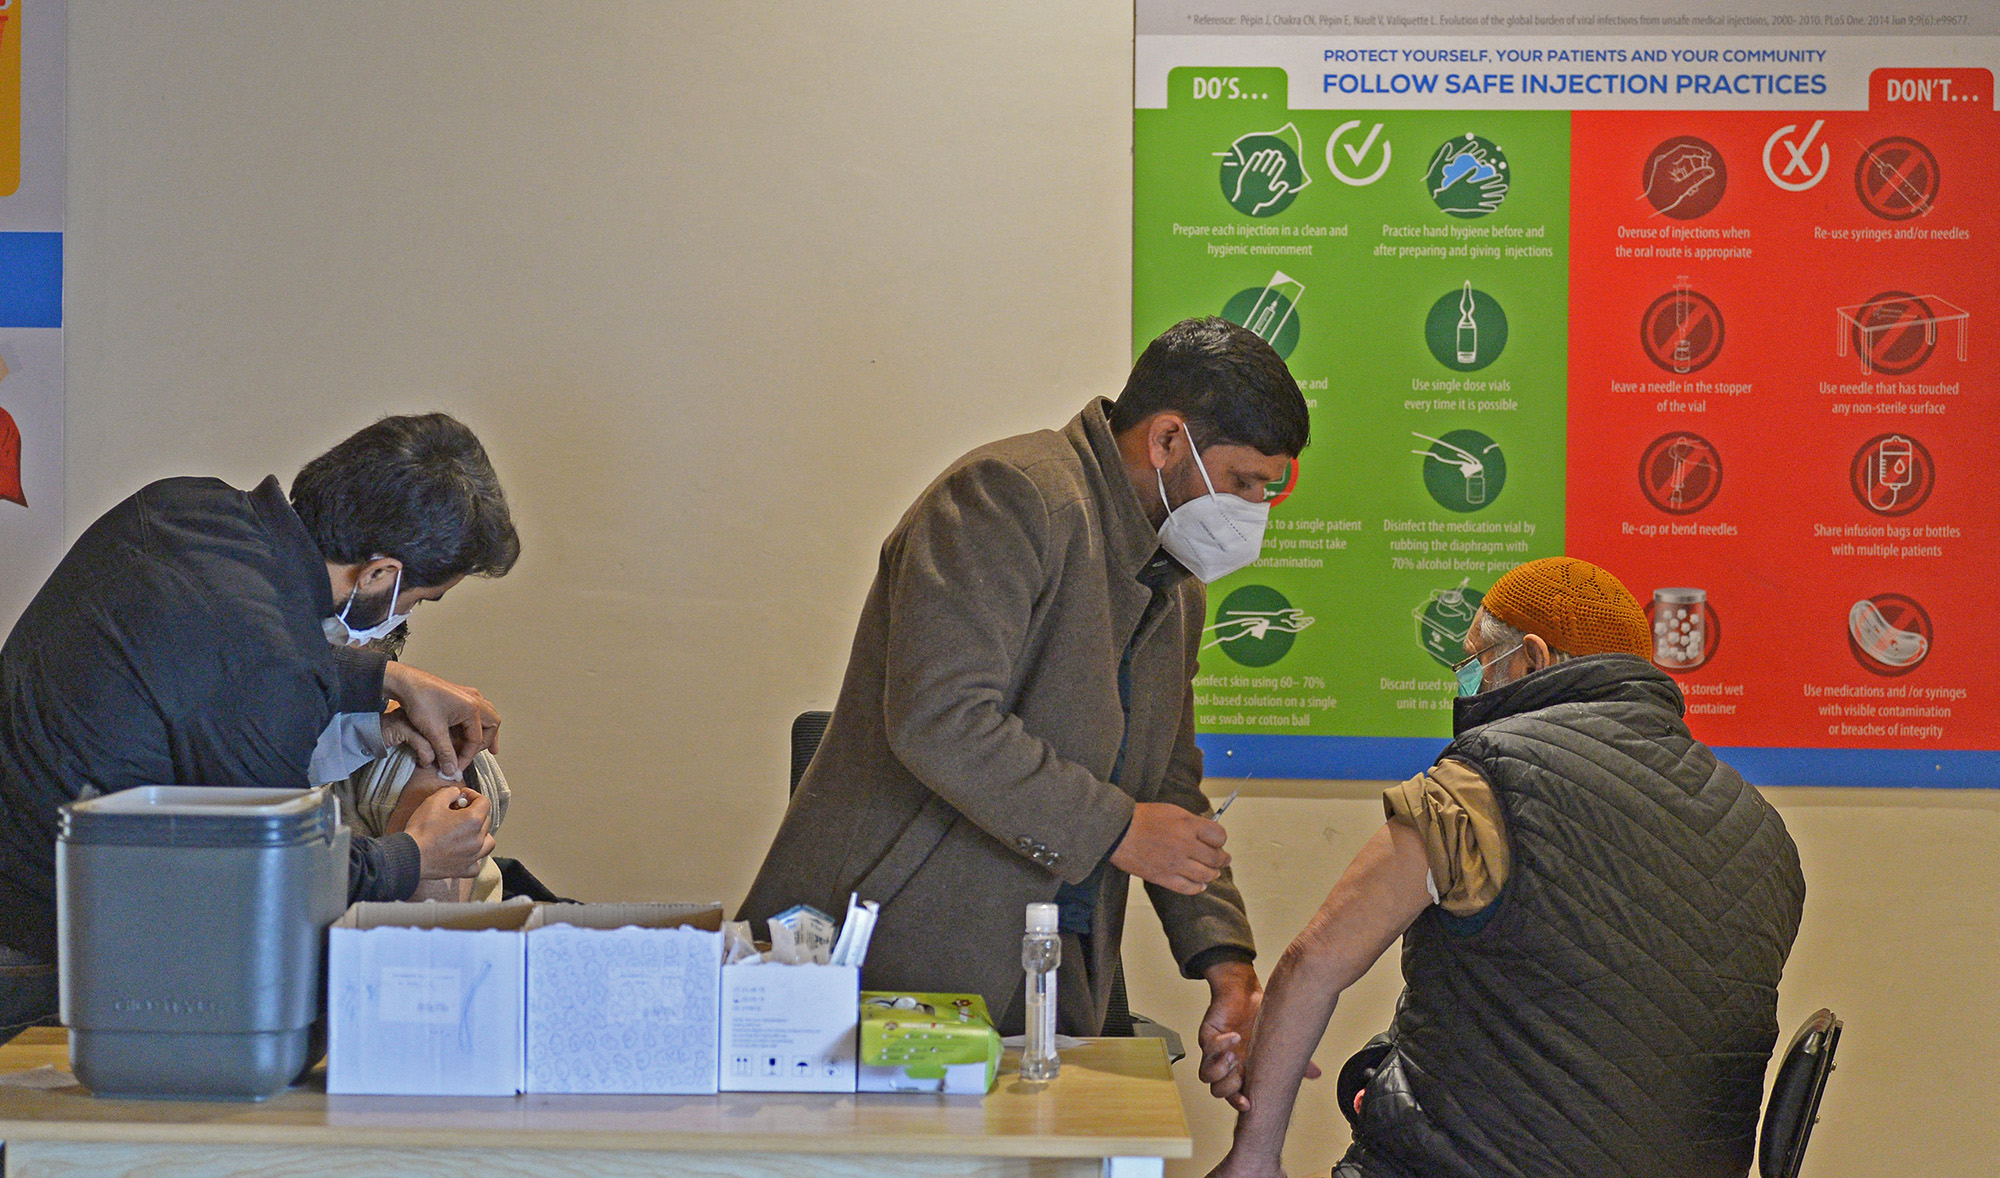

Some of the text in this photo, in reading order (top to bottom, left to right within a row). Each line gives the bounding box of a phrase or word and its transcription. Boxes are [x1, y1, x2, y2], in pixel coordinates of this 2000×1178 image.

[1324, 49, 1828, 66] PROTECT YOURSELF, YOUR PATIENTS AND YOUR COMMUNITY
[1192, 76, 1269, 101] DO'S...
[1323, 73, 1828, 95] FOLLOW SAFE INJECTION PRACTICES
[1886, 78, 1980, 103] DON'T...
[1172, 222, 1349, 240] Prepare each injection in a clean and
[1382, 223, 1546, 241] Practice hand hygiene before and
[1617, 225, 1751, 242] Overuse of injections when
[1814, 226, 1970, 243] Re-use syringes and/or needles
[1207, 243, 1313, 259] hygienic environment
[1373, 243, 1554, 261] after preparing and giving injections
[1615, 244, 1752, 262] the oral route is appropriate
[1308, 376, 1329, 390] and
[1411, 377, 1511, 395] Use single dose vials
[1611, 379, 1752, 398] leave a needle in the stopper
[1819, 380, 1960, 395] Use needle that has touched
[1404, 397, 1519, 415] every time it is possible
[1656, 399, 1707, 413] of the vial
[1832, 400, 1946, 417] any non-sterile surface
[1275, 518, 1286, 530] to
[1287, 520, 1294, 530] a
[1295, 518, 1325, 534] single
[1326, 518, 1363, 534] patient
[1383, 519, 1536, 537] Disinfect the medication vial by
[1621, 521, 1738, 539] Re-cap or bend needles
[1813, 523, 1961, 541] Share infusion bags or bottles
[1279, 536, 1347, 553] you must take
[1390, 537, 1529, 555] rubbing the diaphragm with
[1831, 542, 1943, 560] with multiple patients
[1252, 556, 1324, 569] contamination
[1392, 556, 1415, 570] 70%
[1416, 556, 1453, 570] alcohol
[1453, 557, 1486, 571] before
[1230, 675, 1250, 688] skin
[1251, 675, 1279, 692] using
[1303, 675, 1326, 688] 70%
[1379, 677, 1416, 691] Discard
[1417, 677, 1442, 691] used
[1691, 683, 1723, 696] stored
[1724, 683, 1744, 696] wet
[1803, 684, 1822, 697] Use
[1823, 684, 1885, 698] medications
[1886, 684, 1907, 698] and
[1925, 685, 1967, 702] syringes
[1243, 694, 1337, 712] solution on a single
[1396, 697, 1417, 710] unit
[1418, 697, 1429, 710] in
[1430, 700, 1437, 710] a
[1689, 703, 1736, 715] container
[1818, 703, 1952, 718] with visible contamination
[1199, 712, 1311, 726] use swab or cotton ball
[1828, 722, 1944, 740] or breaches of integrity
